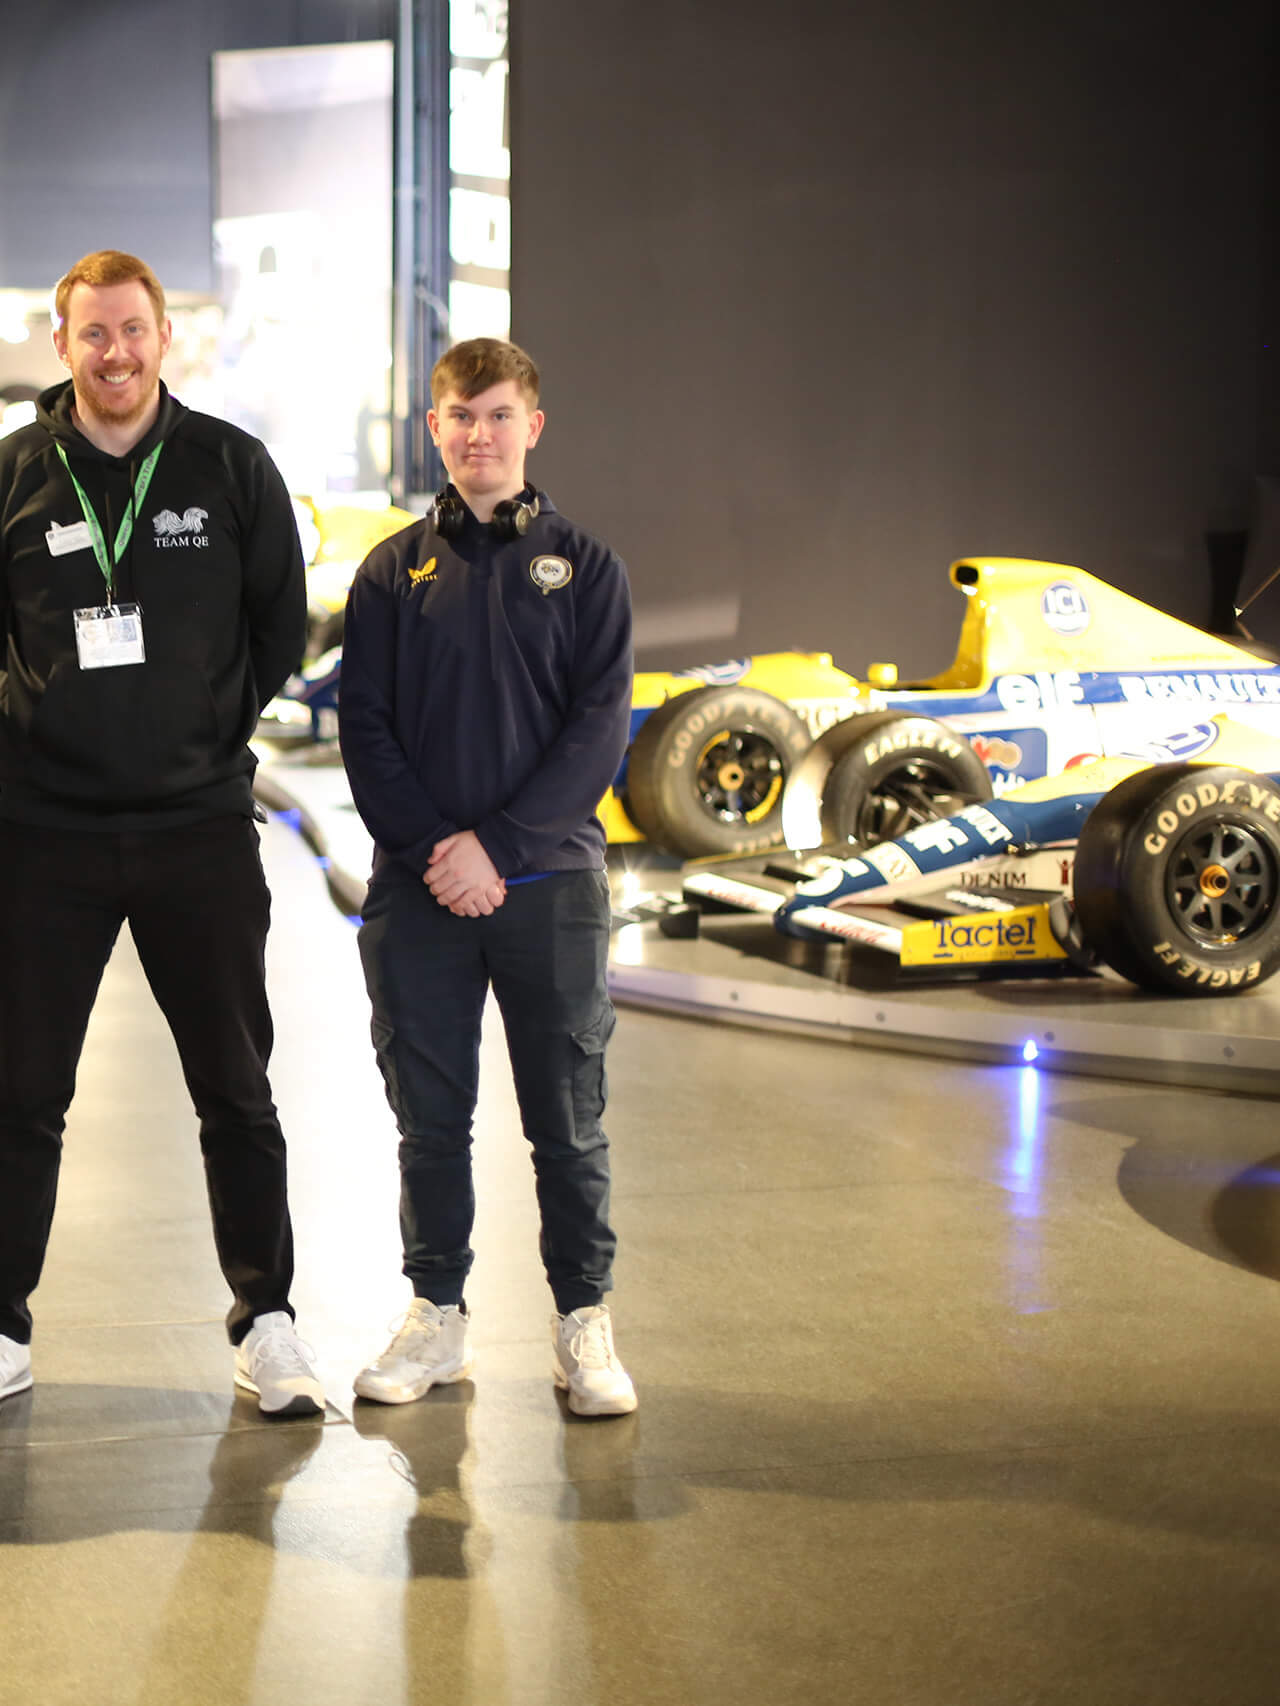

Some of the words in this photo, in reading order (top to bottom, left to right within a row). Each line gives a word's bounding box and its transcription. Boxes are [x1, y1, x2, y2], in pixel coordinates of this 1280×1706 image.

[154, 536, 189, 548] TEAM
[192, 535, 209, 550] QE
[863, 731, 937, 767] EAGLE
[960, 871, 1027, 888] DENIM
[933, 915, 1037, 949] Tactel
[1177, 959, 1263, 988] EAGLE
